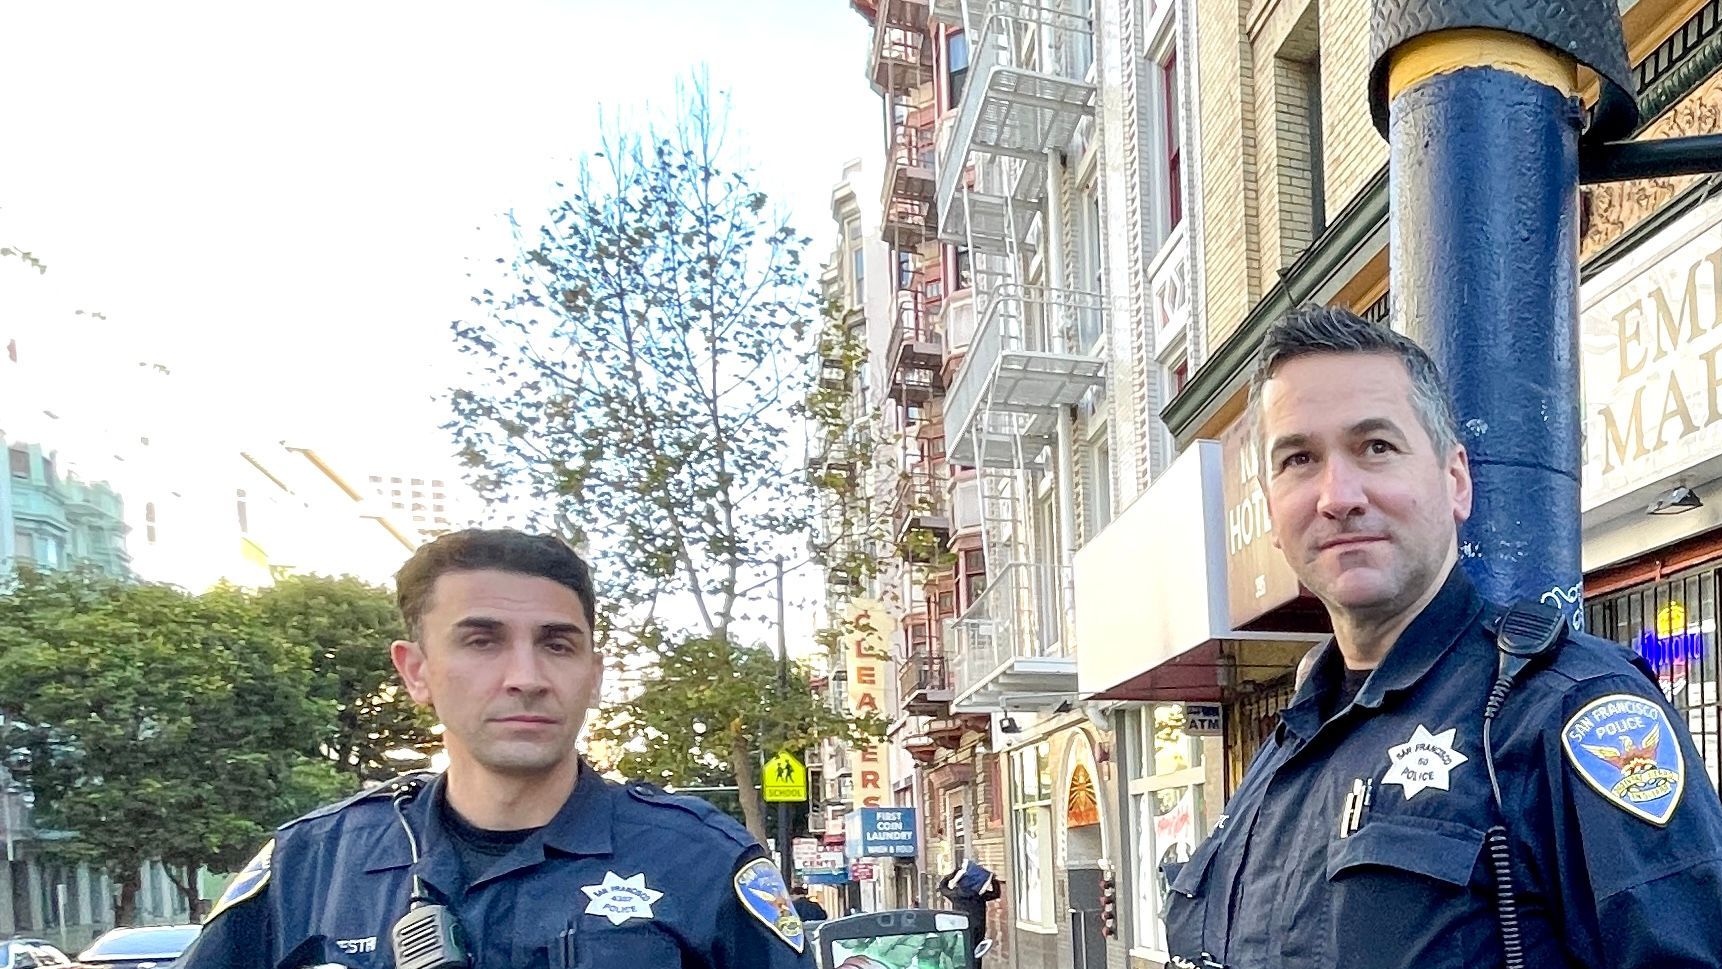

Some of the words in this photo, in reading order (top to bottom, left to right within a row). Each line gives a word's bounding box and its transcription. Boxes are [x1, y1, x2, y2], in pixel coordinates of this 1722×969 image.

[854, 610, 881, 808] CLEAERS
[1188, 719, 1220, 731] ATM
[1569, 716, 1595, 742] SAN
[1592, 701, 1658, 721] FRANCISCO
[1595, 716, 1647, 739] POLICE
[1396, 746, 1412, 761] SAN
[1415, 743, 1452, 766] FRANCISCO
[1401, 766, 1435, 782] POLICE
[768, 788, 802, 798] SCHOOL
[876, 811, 902, 821] FIRST
[876, 821, 903, 831] COIN
[866, 831, 913, 841] LAUNDRY
